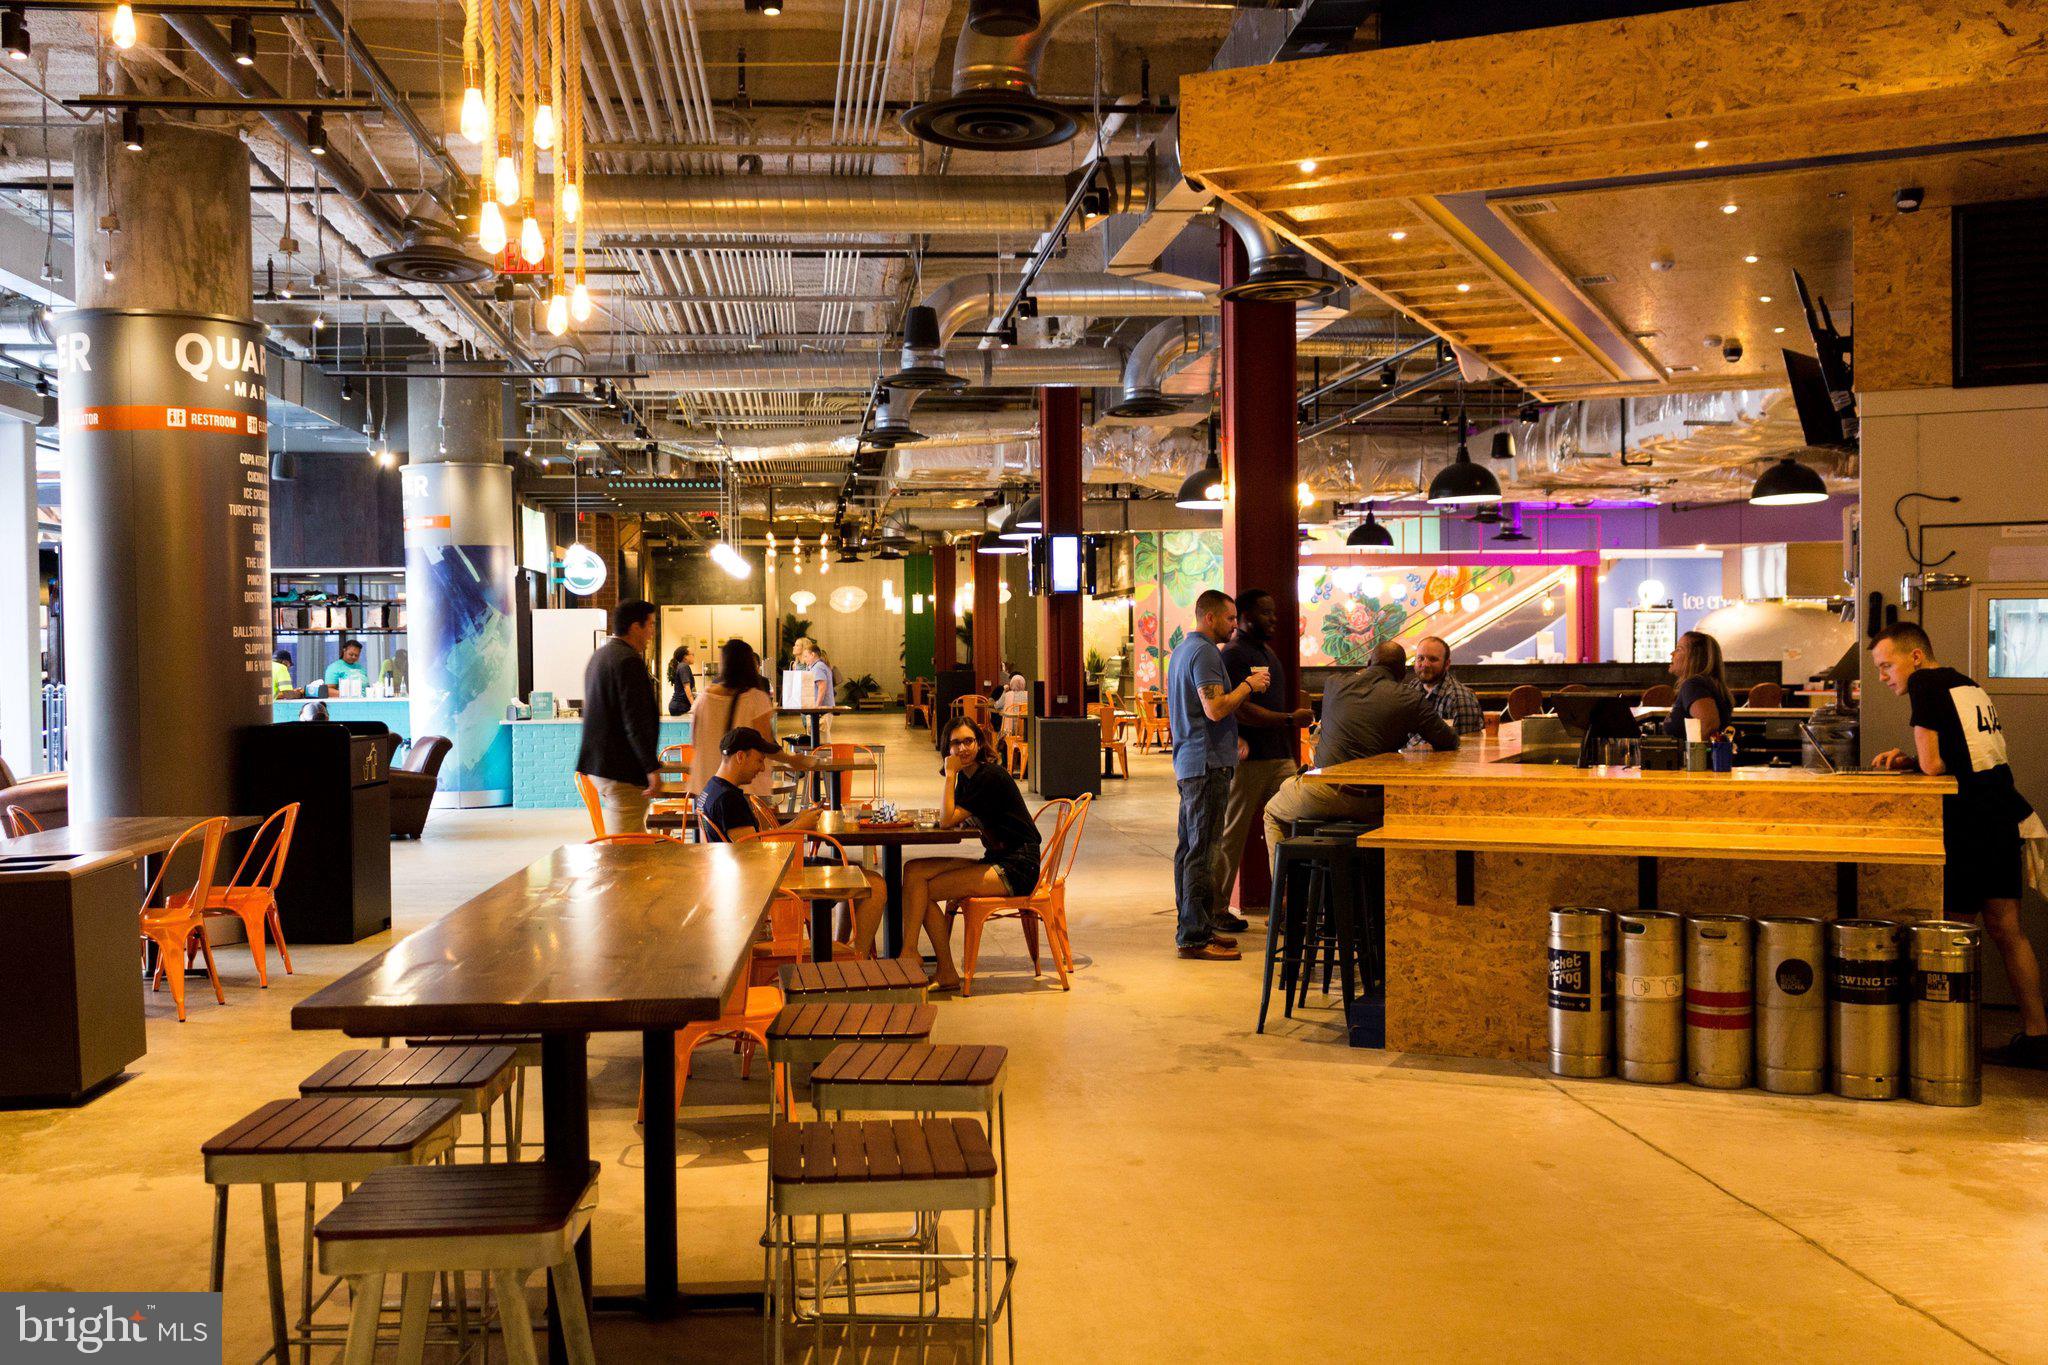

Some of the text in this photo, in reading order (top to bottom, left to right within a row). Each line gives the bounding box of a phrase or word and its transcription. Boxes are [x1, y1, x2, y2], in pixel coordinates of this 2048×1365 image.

[191, 413, 237, 428] RESTROOM
[240, 452, 255, 465] COPA
[243, 487, 253, 499] ICE
[245, 556, 257, 568] THE
[1683, 592, 1704, 610] ice
[1551, 970, 1581, 990] Frog
